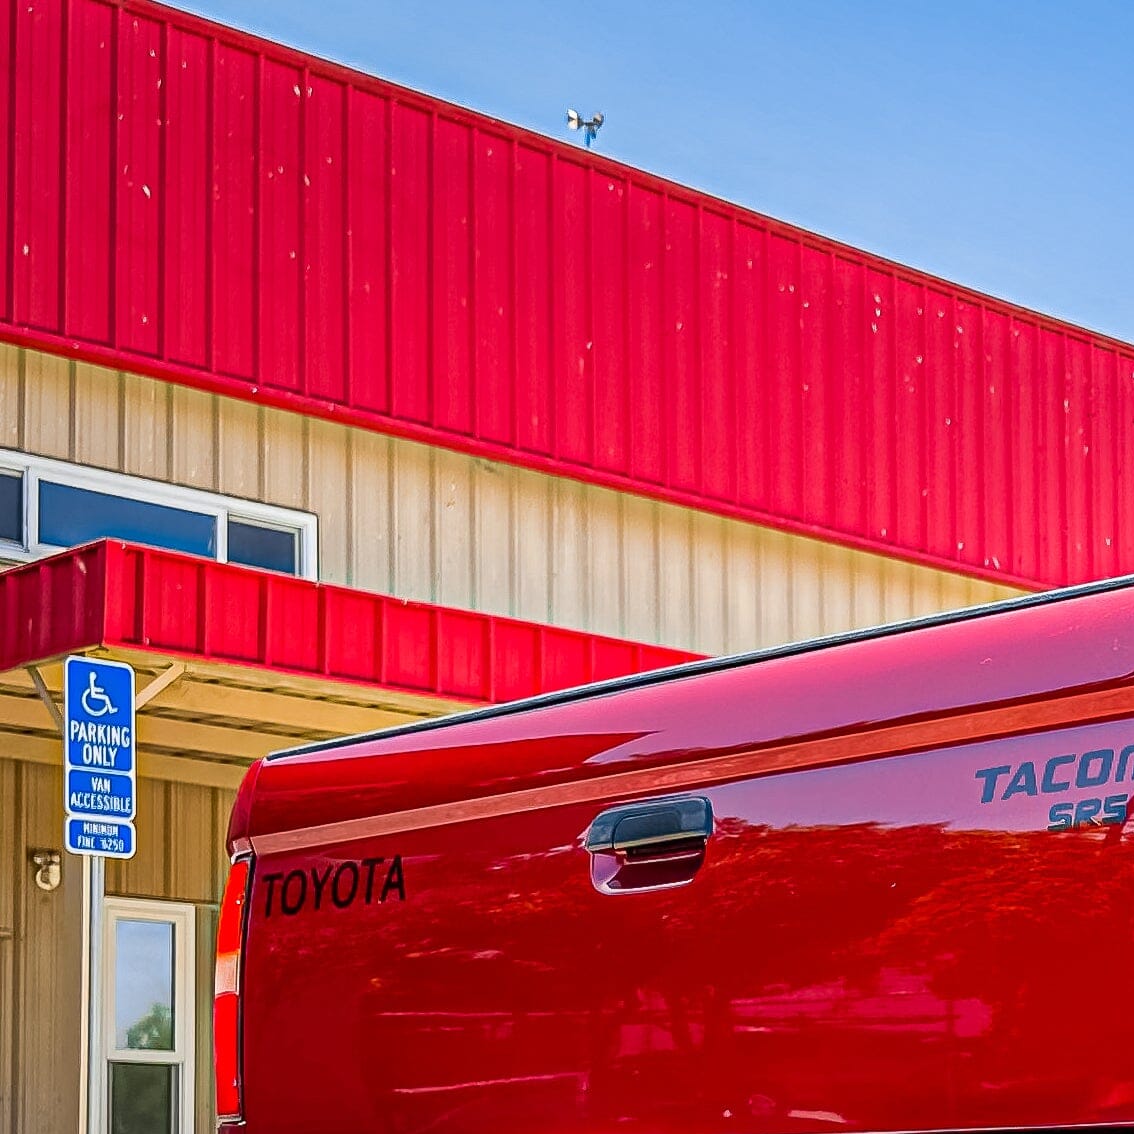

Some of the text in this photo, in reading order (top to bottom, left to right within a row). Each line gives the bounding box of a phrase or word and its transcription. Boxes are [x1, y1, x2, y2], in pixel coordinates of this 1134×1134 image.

[71, 719, 130, 748] PARKING
[83, 743, 117, 768] ONLY
[91, 776, 111, 794] VAN
[71, 791, 132, 814] ACCESSIBLE
[1047, 794, 1129, 830] SR5
[83, 821, 119, 837] MINIMUM
[262, 853, 406, 918] TOYOTA
